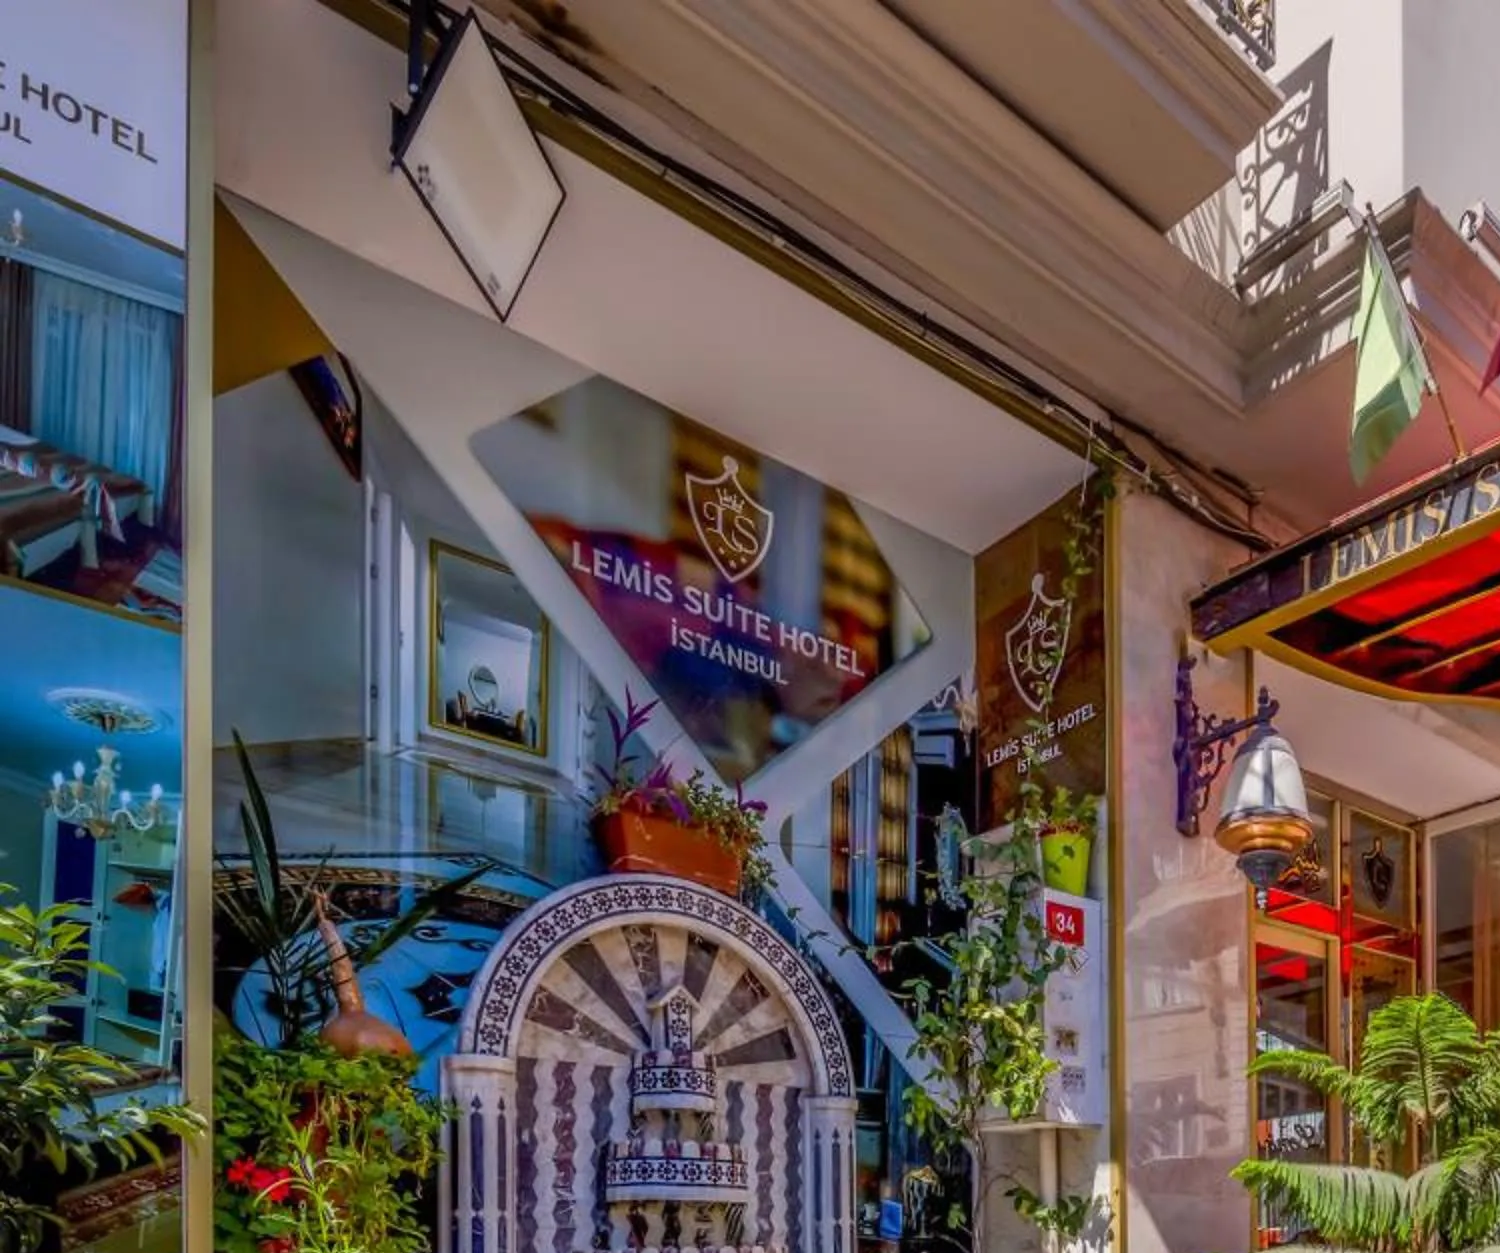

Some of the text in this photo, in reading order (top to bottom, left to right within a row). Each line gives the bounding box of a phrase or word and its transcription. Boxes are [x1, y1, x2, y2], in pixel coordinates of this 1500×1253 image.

[21, 73, 158, 164] HOTEL
[779, 621, 866, 677] HOTEL
[1057, 703, 1097, 733] HOTEL
